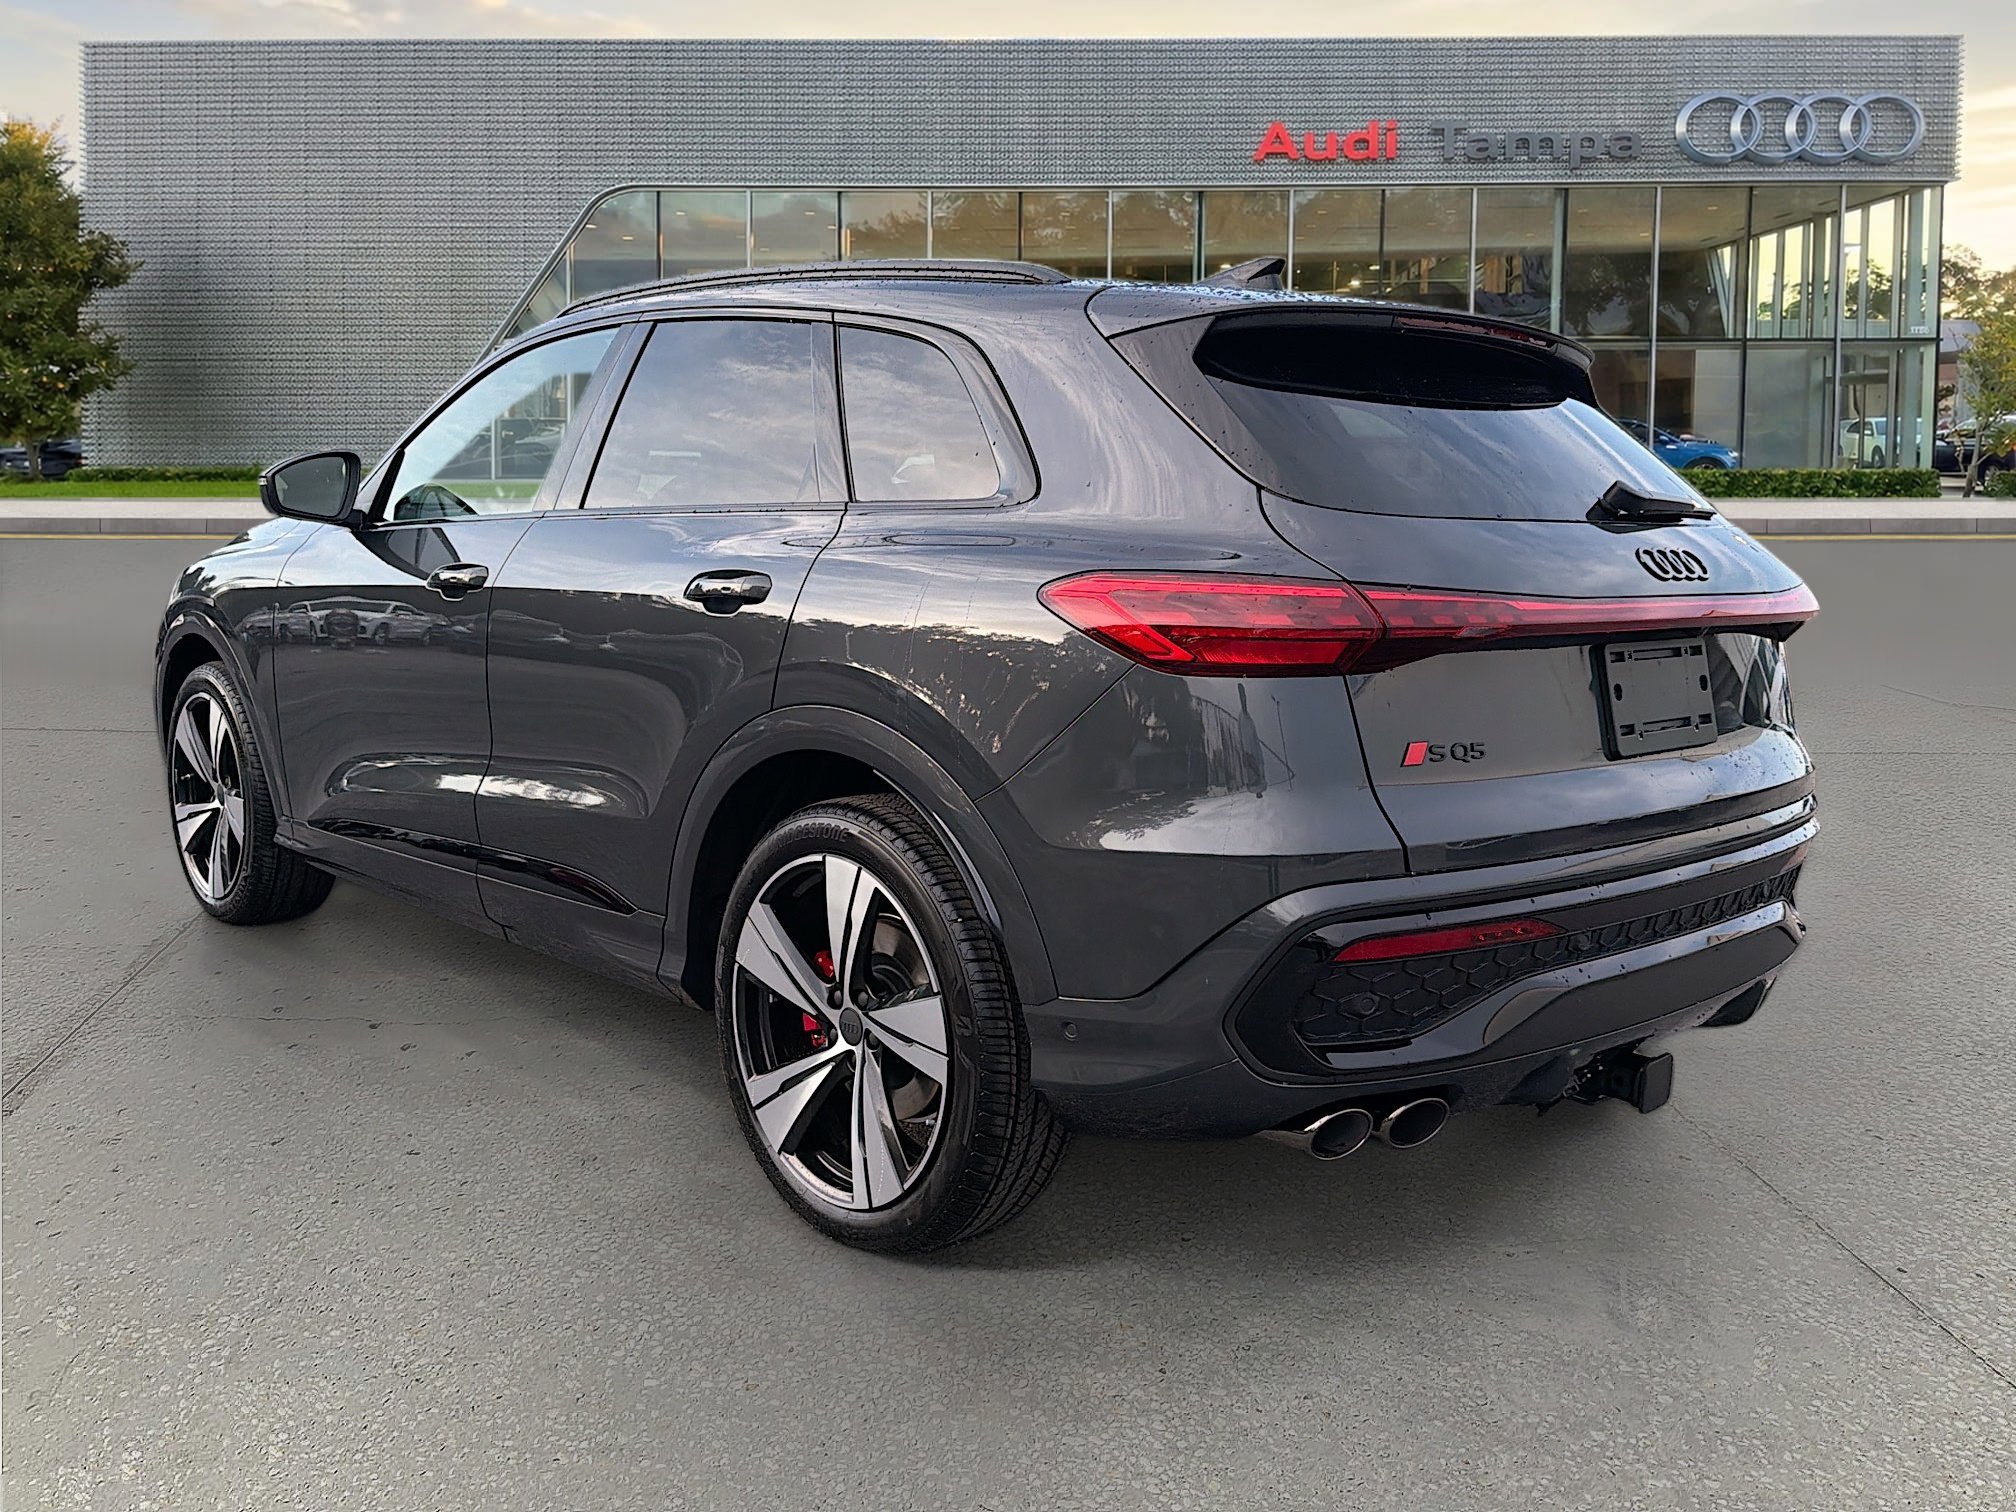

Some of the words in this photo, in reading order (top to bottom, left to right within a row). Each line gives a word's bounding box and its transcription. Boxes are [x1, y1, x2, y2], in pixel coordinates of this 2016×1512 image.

[1254, 119, 1399, 161] Audi
[1431, 120, 1642, 171] Tampa
[1428, 742, 1486, 763] SQ5
